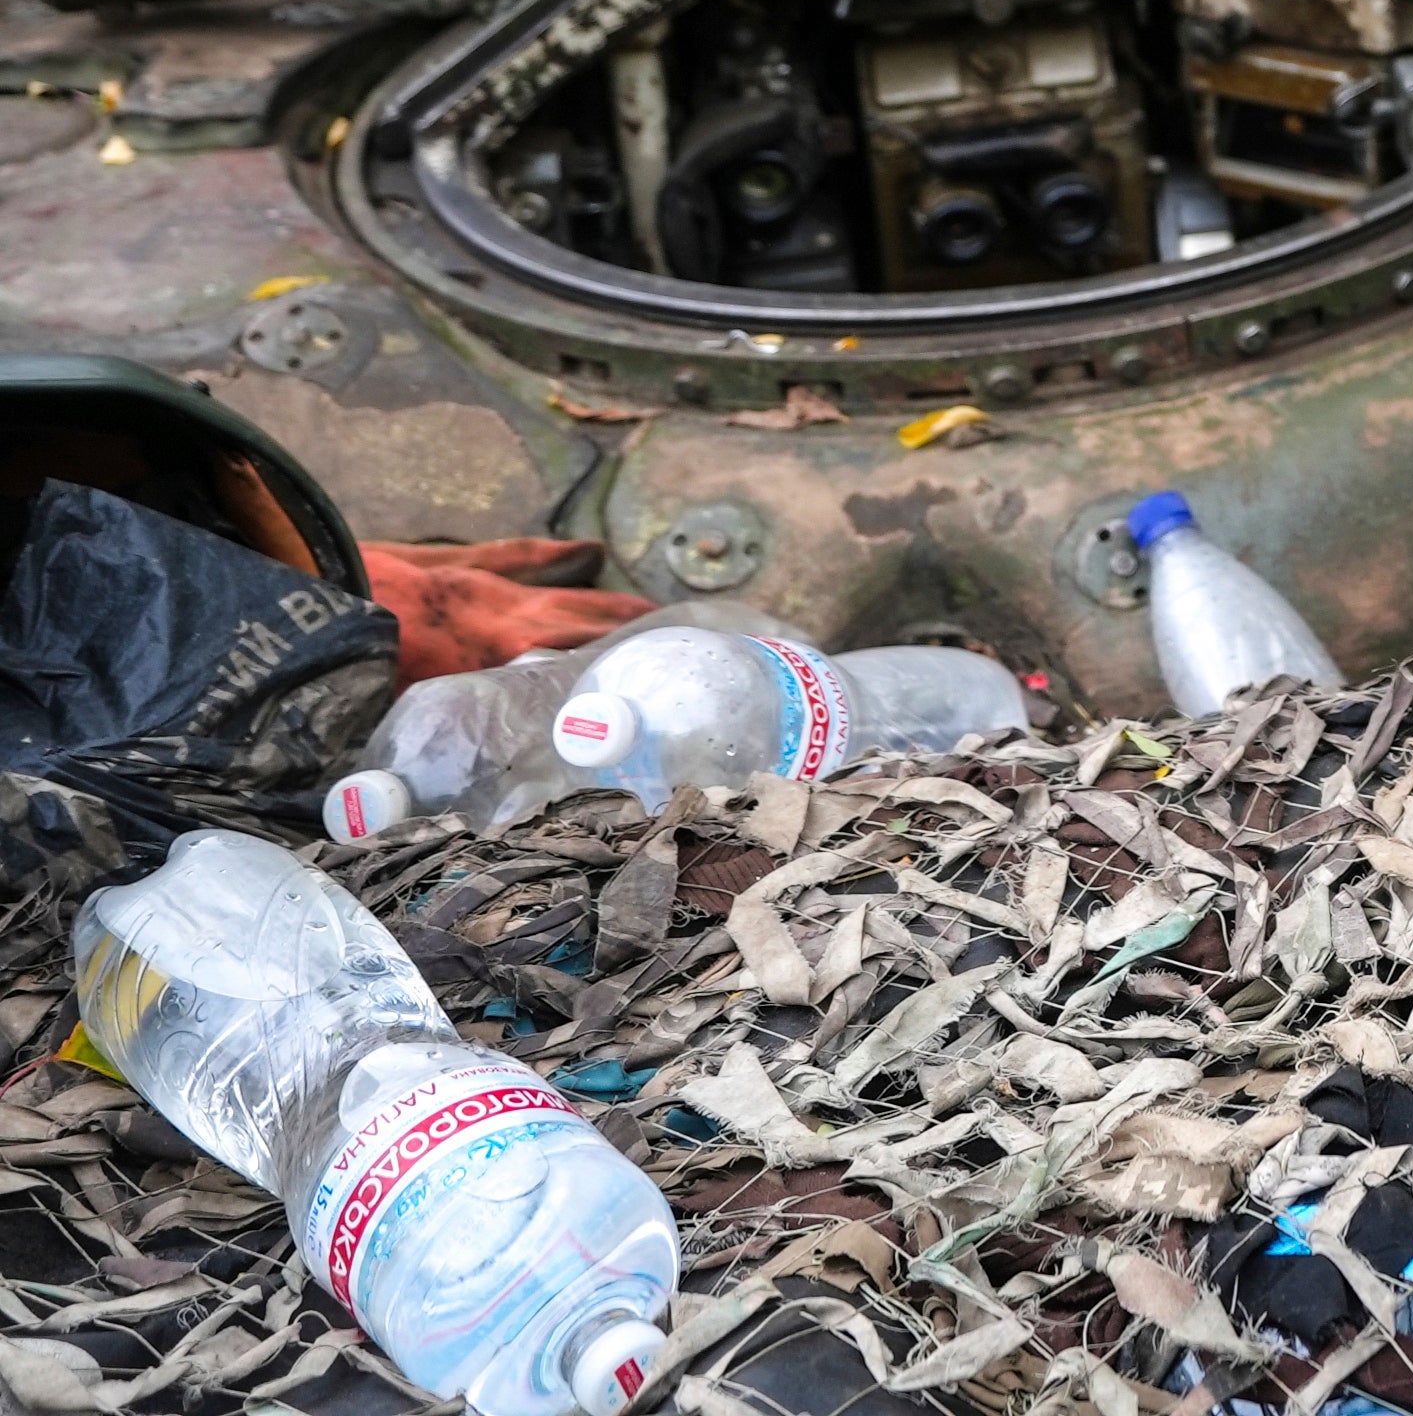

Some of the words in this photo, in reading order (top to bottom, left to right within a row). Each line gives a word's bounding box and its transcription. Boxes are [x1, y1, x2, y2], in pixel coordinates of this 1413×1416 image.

[333, 1081, 438, 1173] ЛАГІДНА
[316, 1182, 334, 1211] 1,5
[331, 1090, 566, 1277] МИРГОРОДСЬКА
